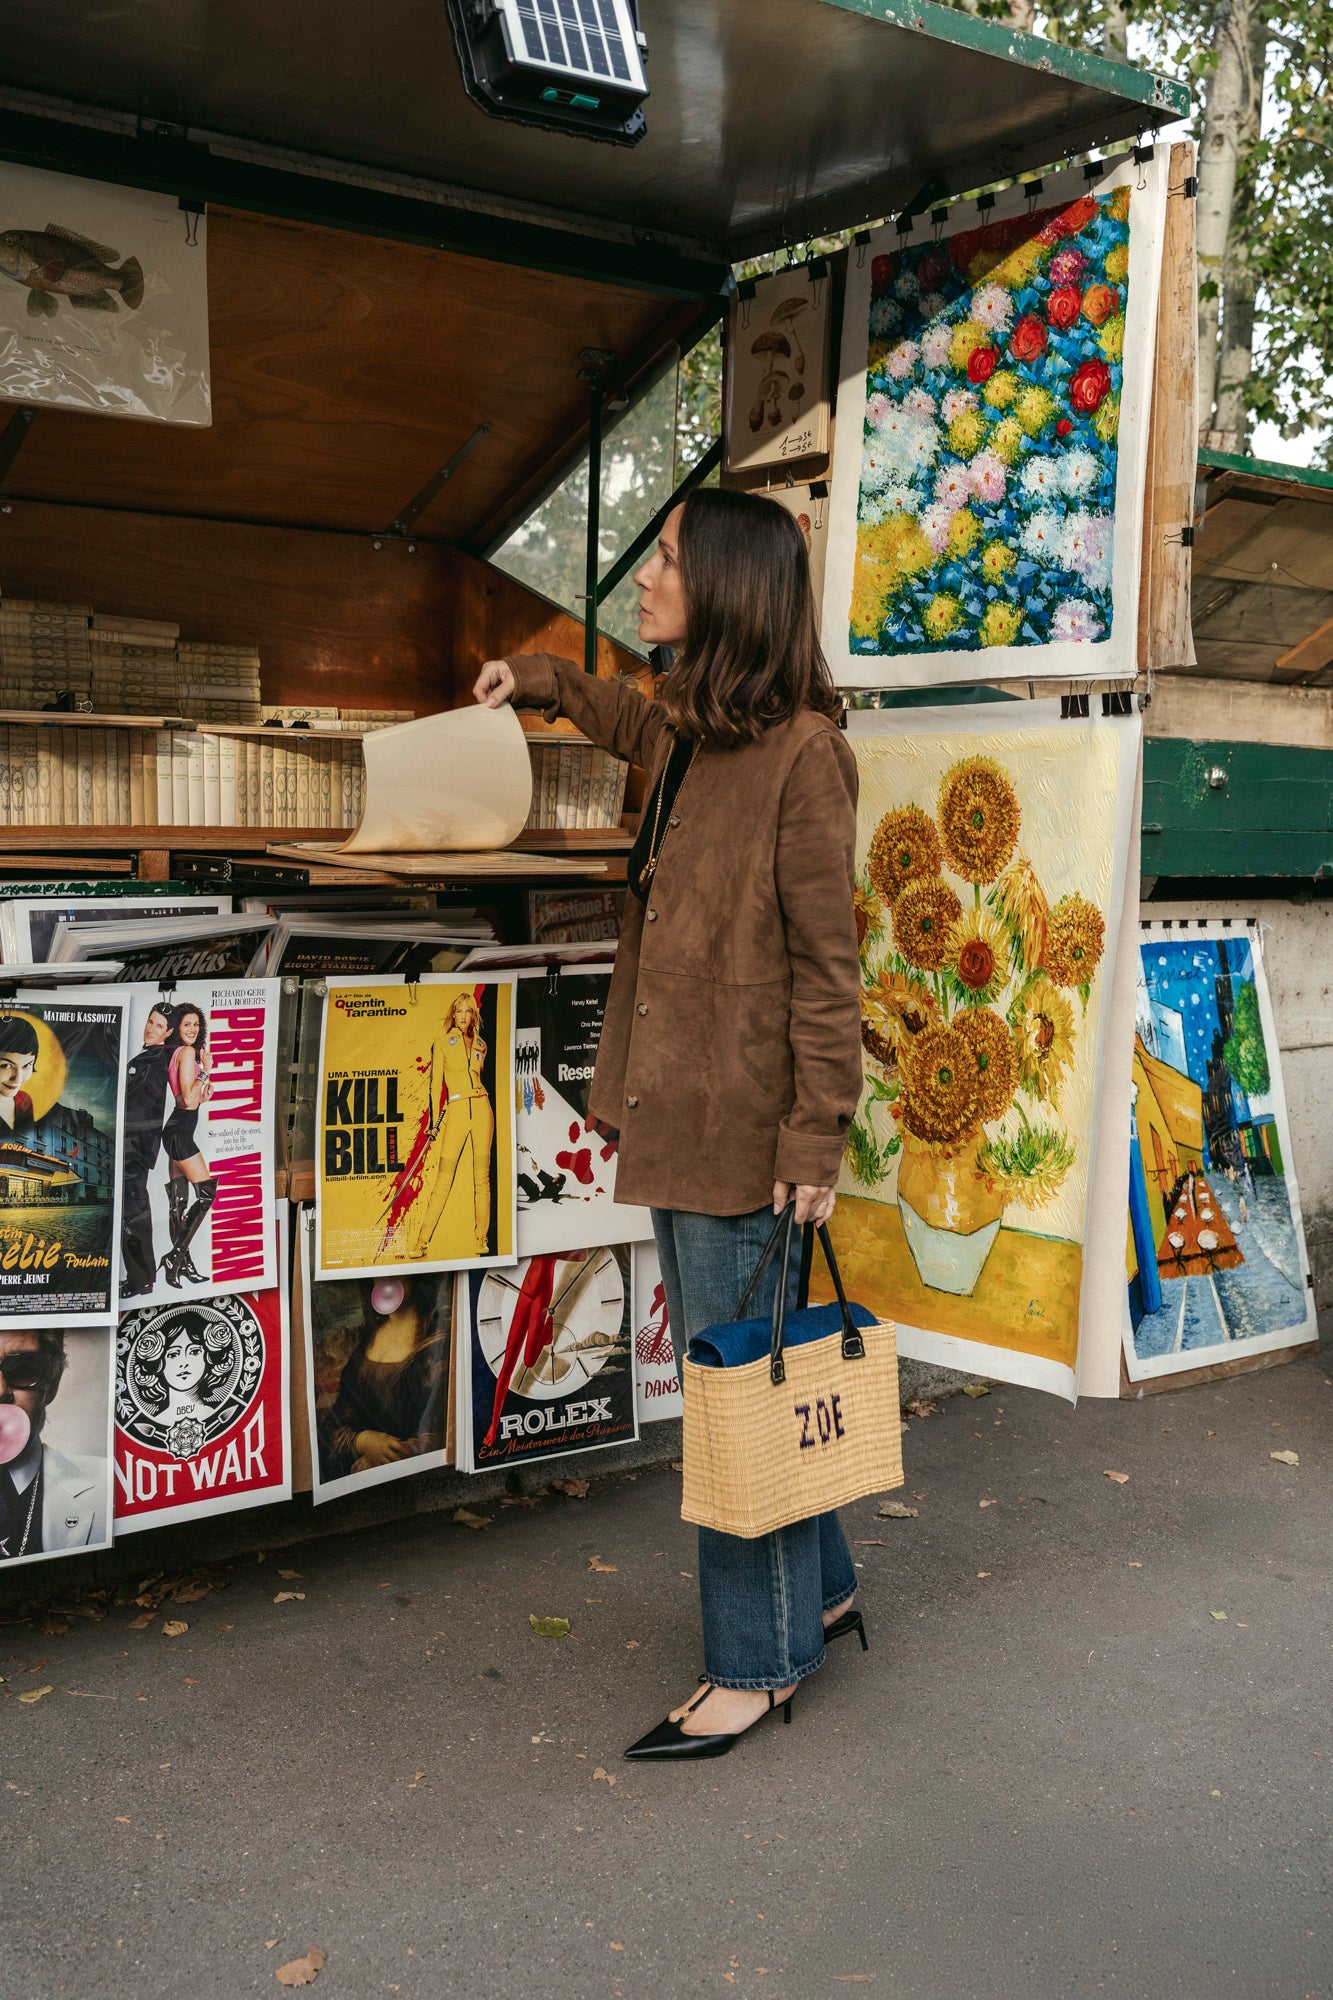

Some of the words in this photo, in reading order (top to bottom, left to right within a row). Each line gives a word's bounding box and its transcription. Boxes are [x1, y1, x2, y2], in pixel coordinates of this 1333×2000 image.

[211, 990, 246, 998] RICHARD
[211, 999, 232, 1007] JULIA
[335, 998, 385, 1010] Quentin
[43, 1010, 76, 1022] MATHIEU
[76, 1011, 117, 1024] KASSOVITZ
[345, 1007, 407, 1018] Tarantino
[208, 1008, 265, 1121] PRETTY
[328, 1071, 349, 1079] UMA
[352, 1069, 399, 1077] THURMAN
[326, 1077, 404, 1126] KILL
[325, 1126, 405, 1176] BILL
[209, 1152, 264, 1284] WOMAN
[63, 1253, 109, 1268] Poulain
[23, 1273, 50, 1284] JEUNET
[500, 1397, 613, 1440] ROLEX
[114, 1450, 182, 1505] NOT
[187, 1402, 269, 1490] WAR
